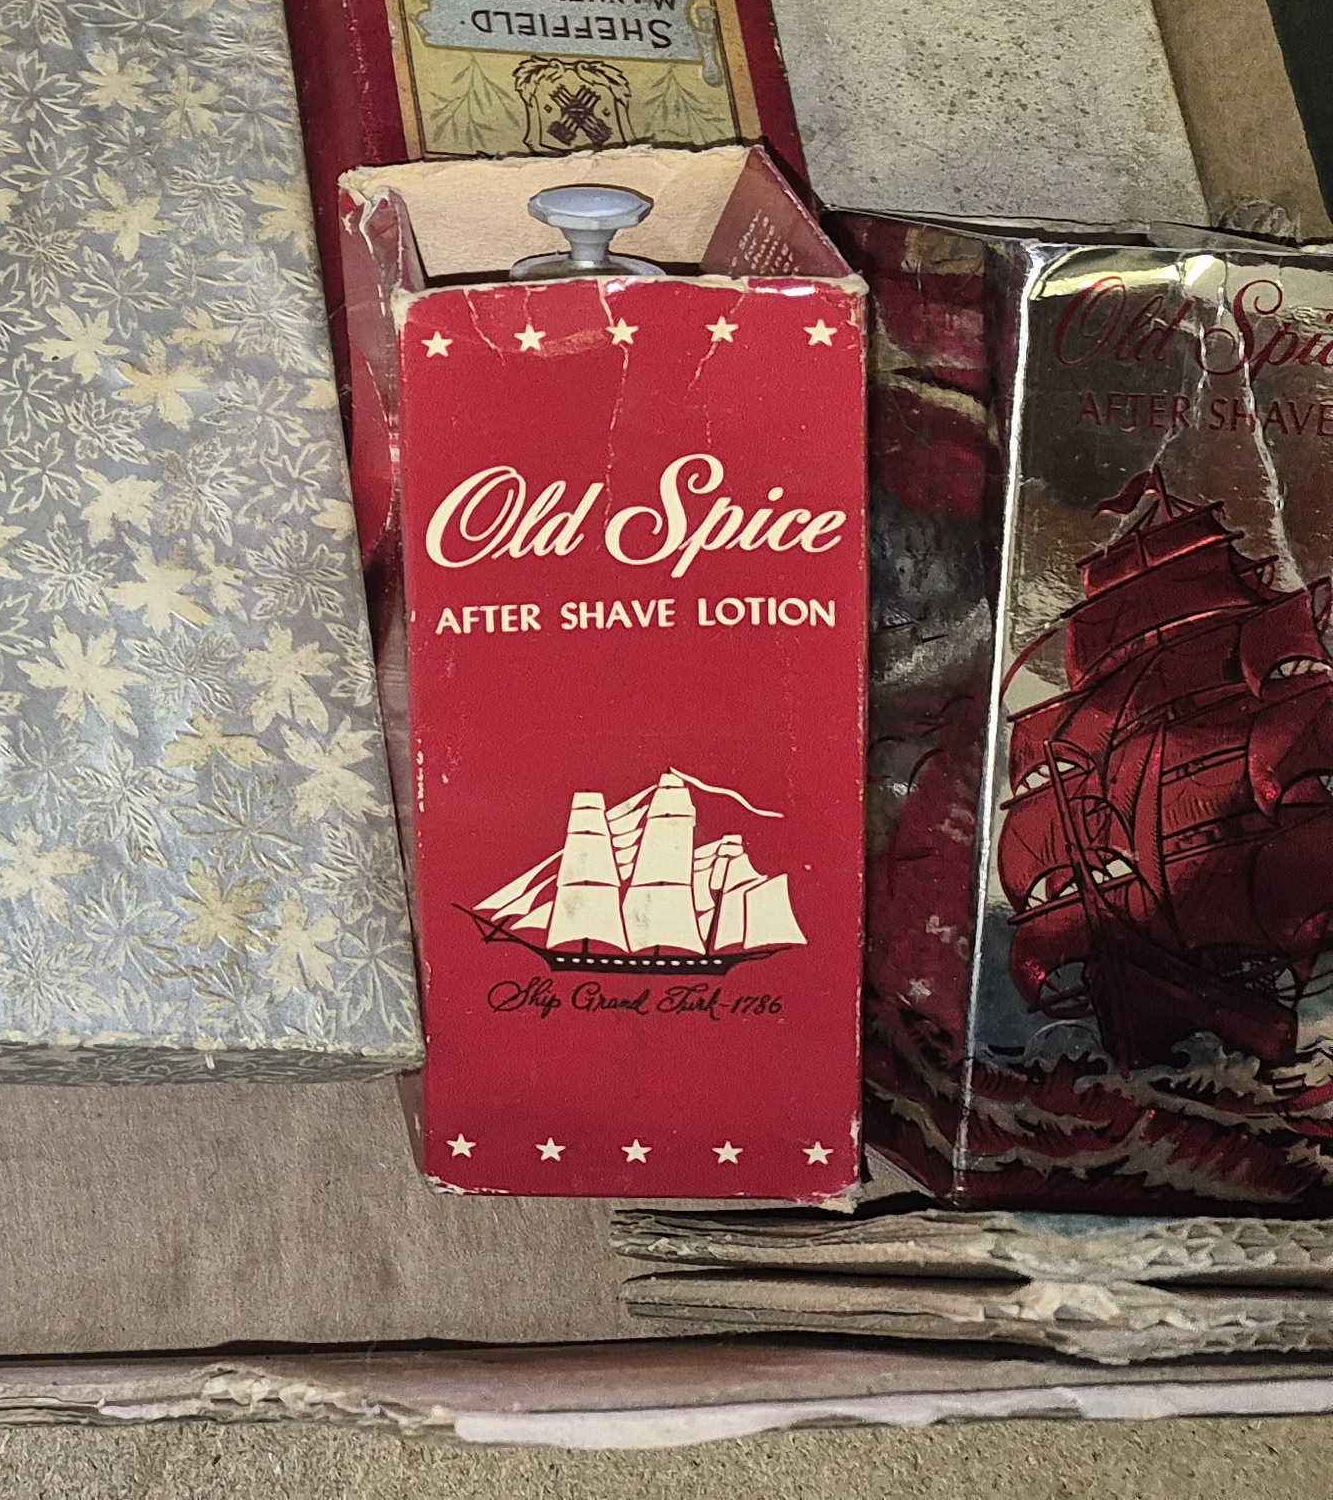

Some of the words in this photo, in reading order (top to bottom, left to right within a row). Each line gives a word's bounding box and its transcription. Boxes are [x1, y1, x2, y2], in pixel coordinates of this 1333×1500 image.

[1054, 276, 1194, 365] Old
[1077, 392, 1191, 429] AFTER
[425, 465, 605, 568] Old
[605, 453, 847, 578] Spice
[435, 603, 541, 635] AFTER
[561, 599, 675, 629] SHAVE
[698, 597, 835, 628] LOTION
[487, 975, 562, 1019] Ship
[571, 981, 651, 1015] Grand
